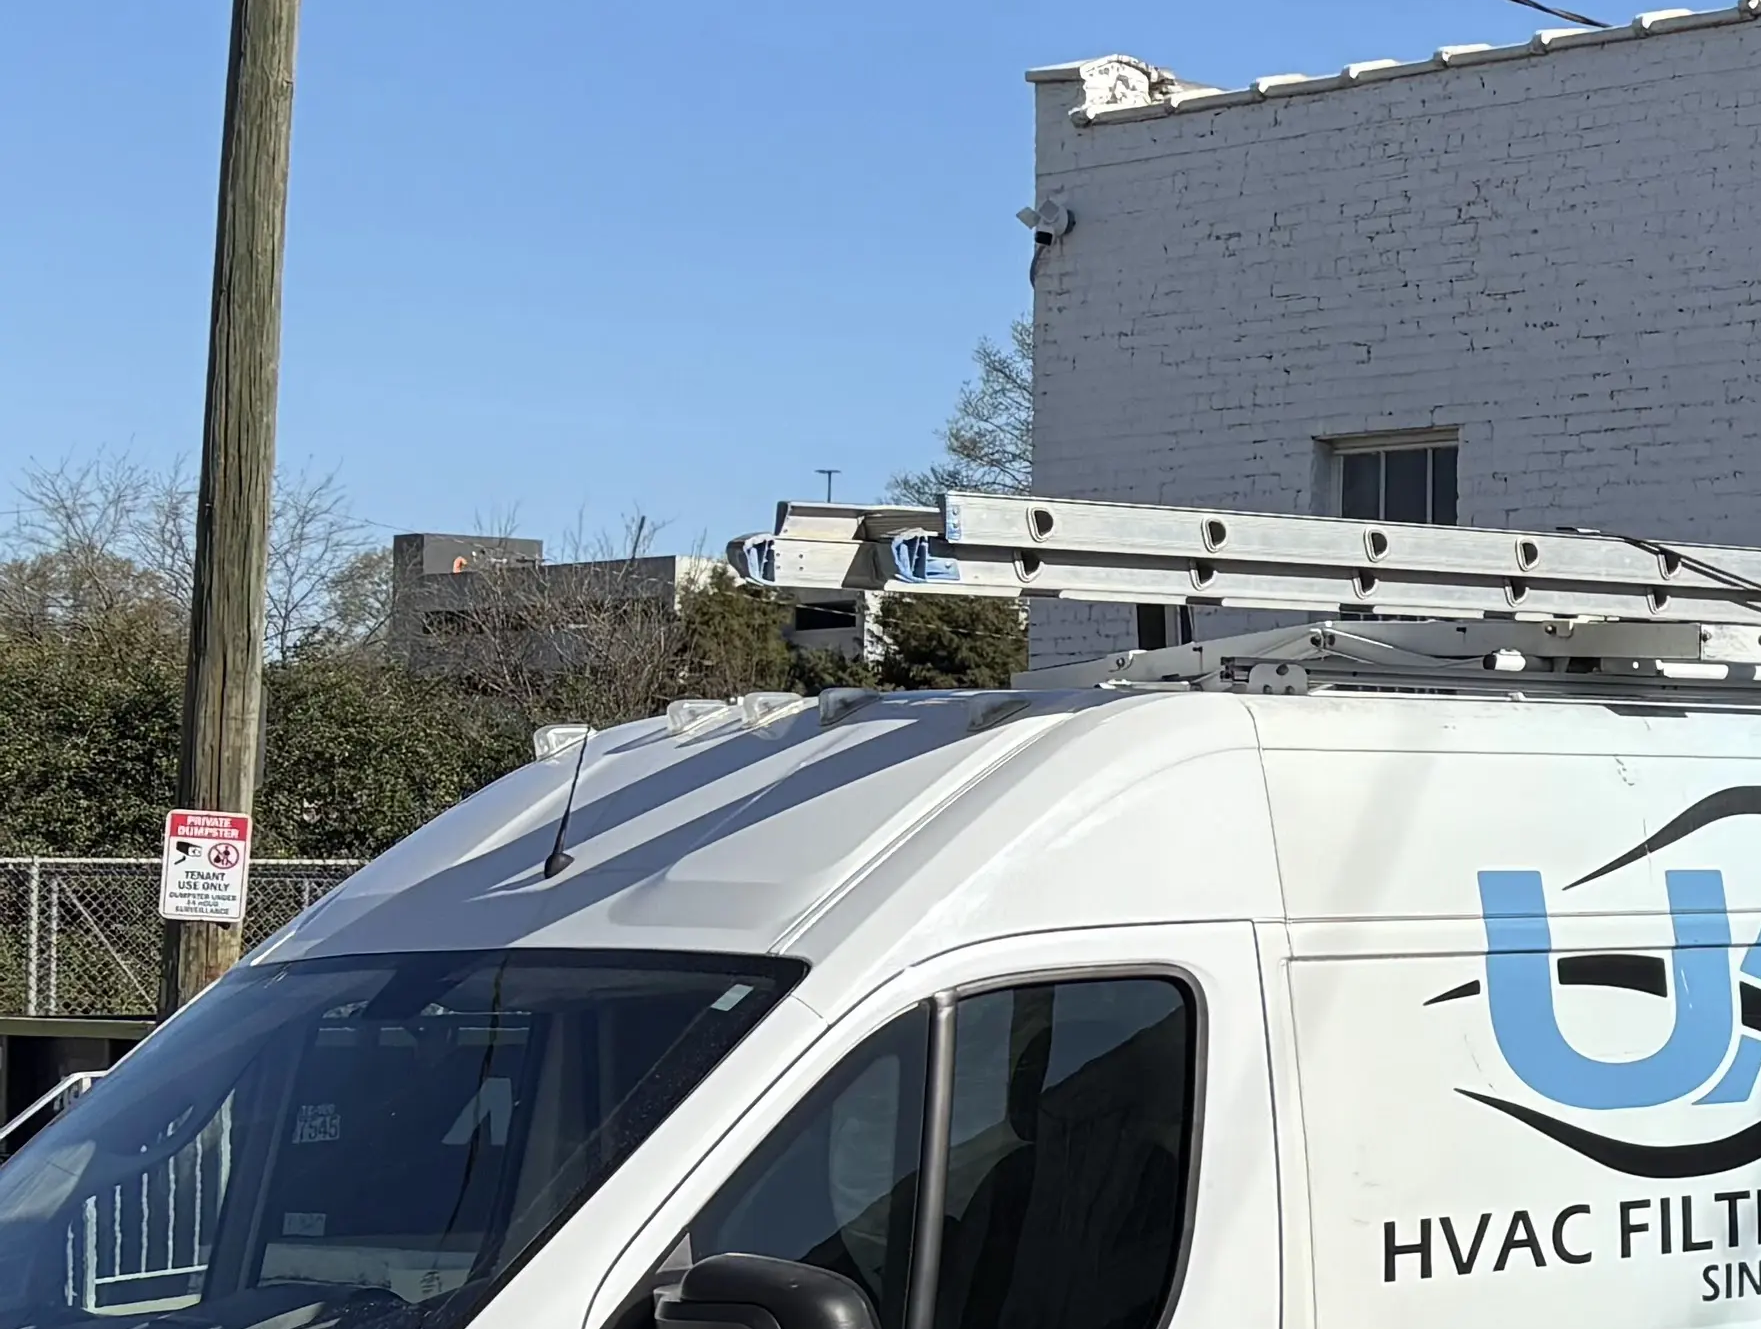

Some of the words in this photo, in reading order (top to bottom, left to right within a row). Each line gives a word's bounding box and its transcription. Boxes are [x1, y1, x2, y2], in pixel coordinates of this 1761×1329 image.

[187, 815, 232, 827] PRIVATE
[177, 825, 240, 839] DUMPSTER
[184, 870, 226, 882] TENANT
[177, 881, 200, 890] USE
[202, 881, 230, 892] ONLY
[1383, 1203, 1593, 1283] HVAC
